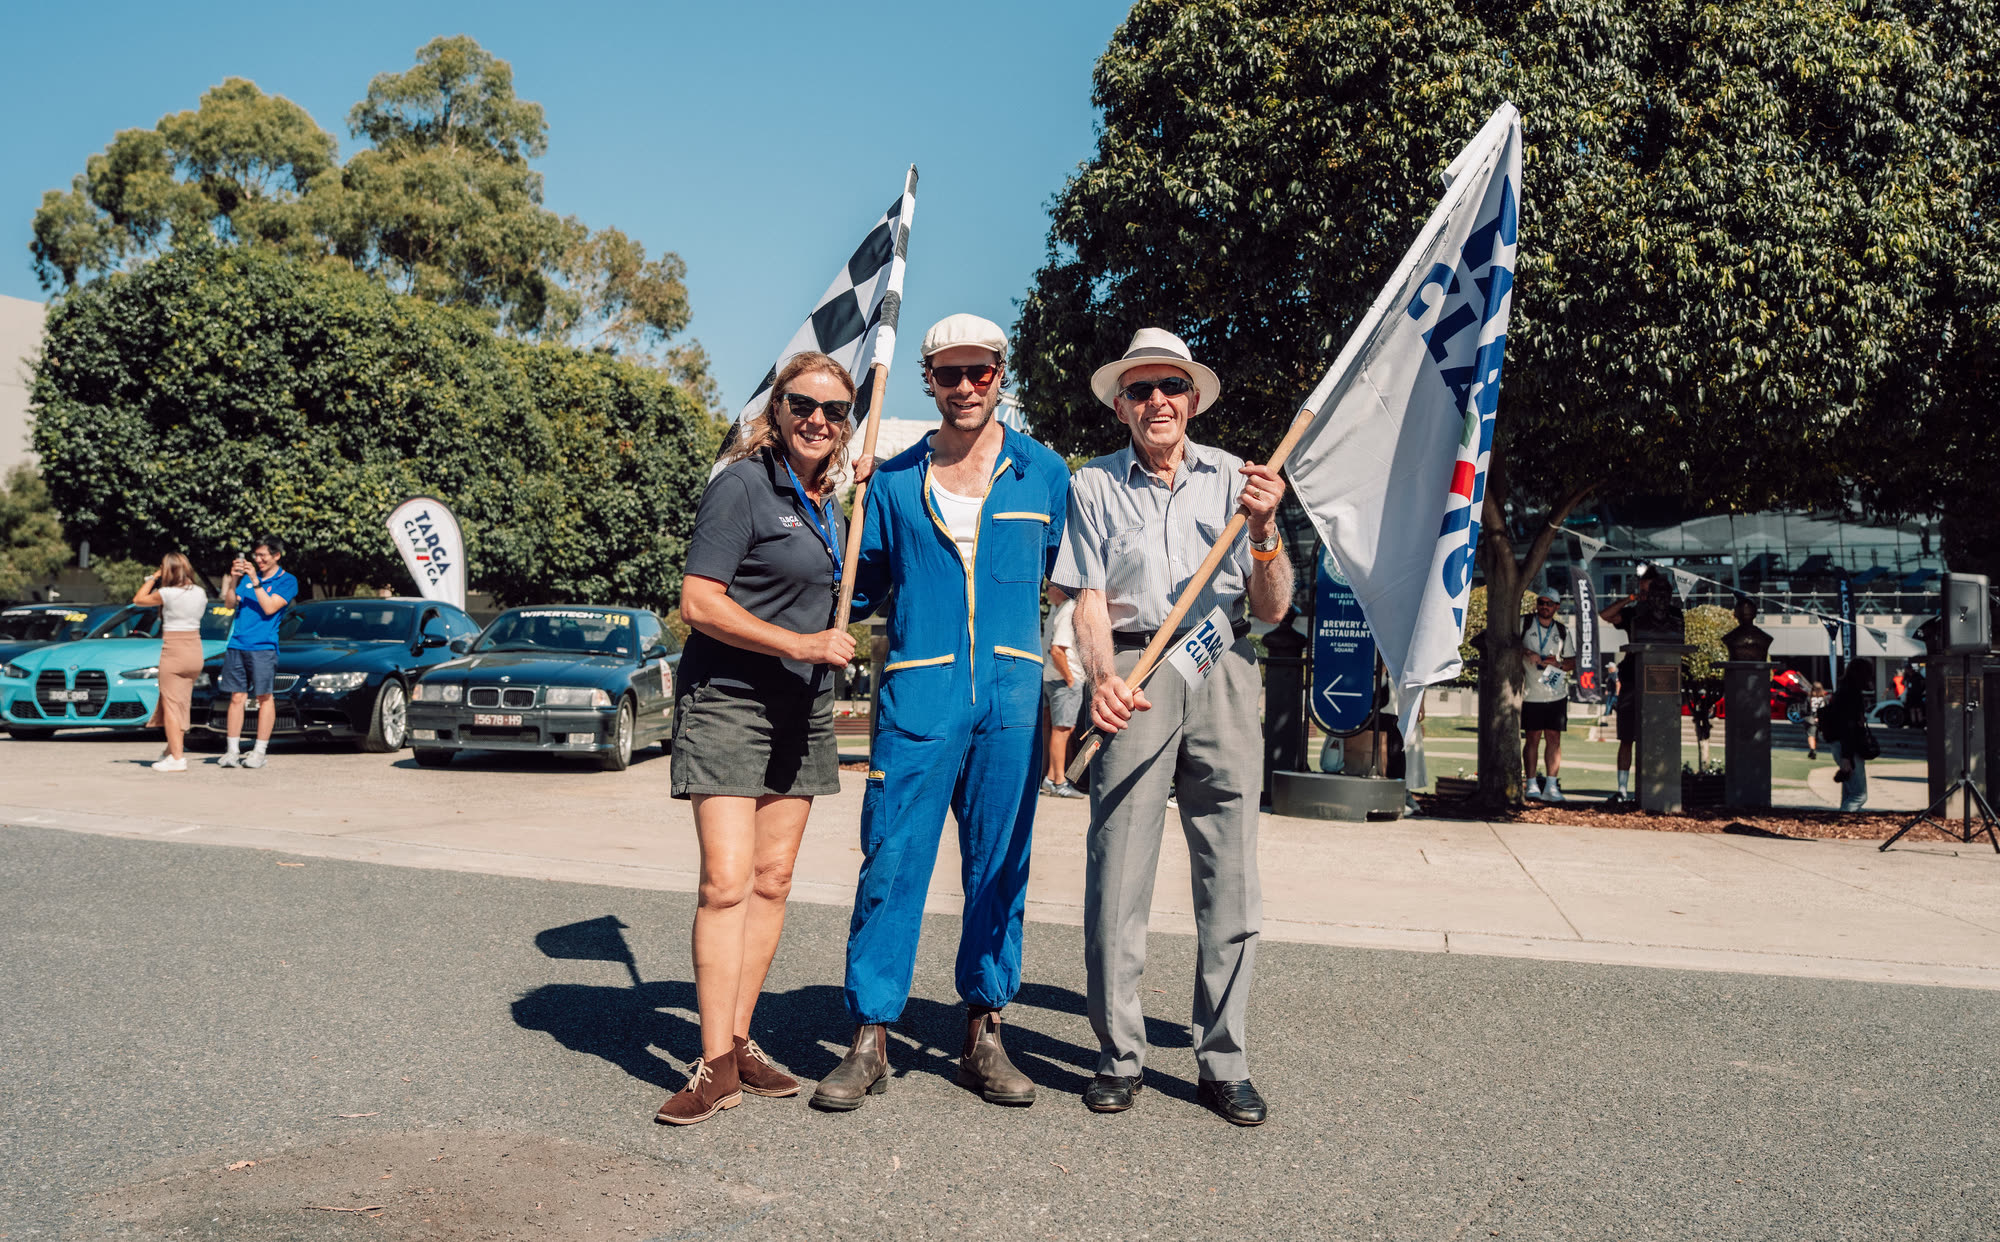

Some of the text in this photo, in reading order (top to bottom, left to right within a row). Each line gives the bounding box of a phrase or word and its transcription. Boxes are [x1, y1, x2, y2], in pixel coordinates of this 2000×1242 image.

[415, 510, 451, 576] TARGA
[520, 611, 594, 619] WIPERTECH
[604, 614, 630, 626] 119
[1323, 620, 1360, 628] BREWERY
[1578, 579, 1592, 668] RIDESPOTR
[1320, 629, 1370, 638] RESTAURANT
[1196, 619, 1225, 666] TARGA
